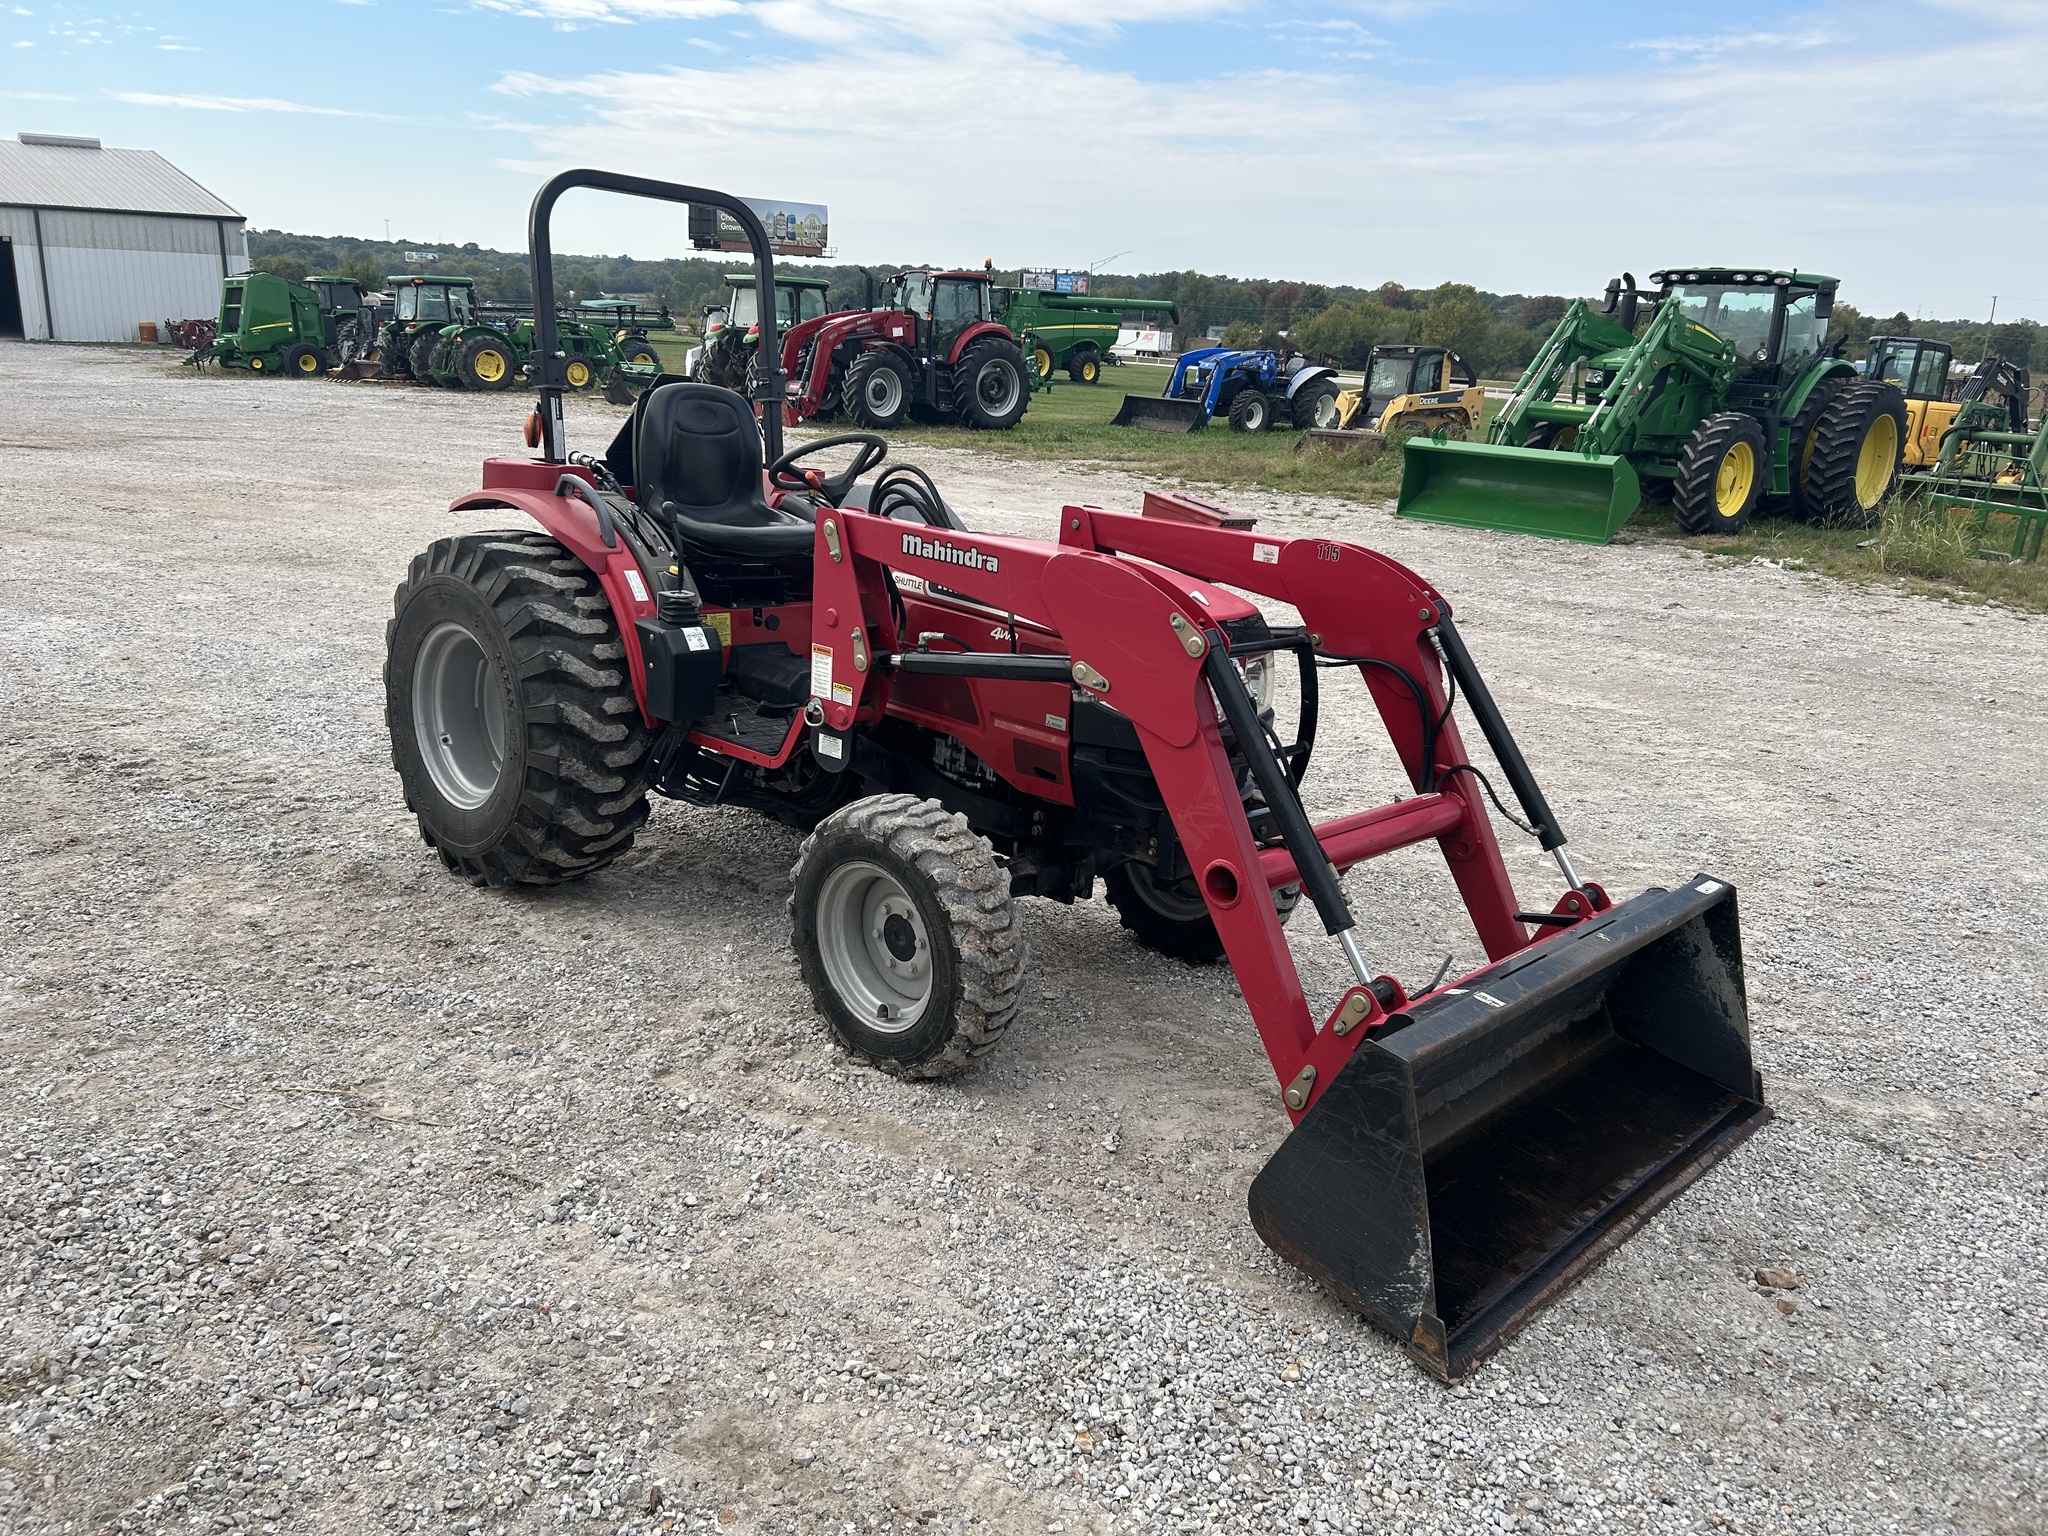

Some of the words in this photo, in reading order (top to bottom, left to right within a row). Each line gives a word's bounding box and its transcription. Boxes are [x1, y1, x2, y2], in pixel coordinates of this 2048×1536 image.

[1419, 397, 1439, 405] DEERE
[901, 533, 999, 573] Mahindra
[1317, 543, 1341, 562] 115
[894, 575, 923, 590] SHUTTLE
